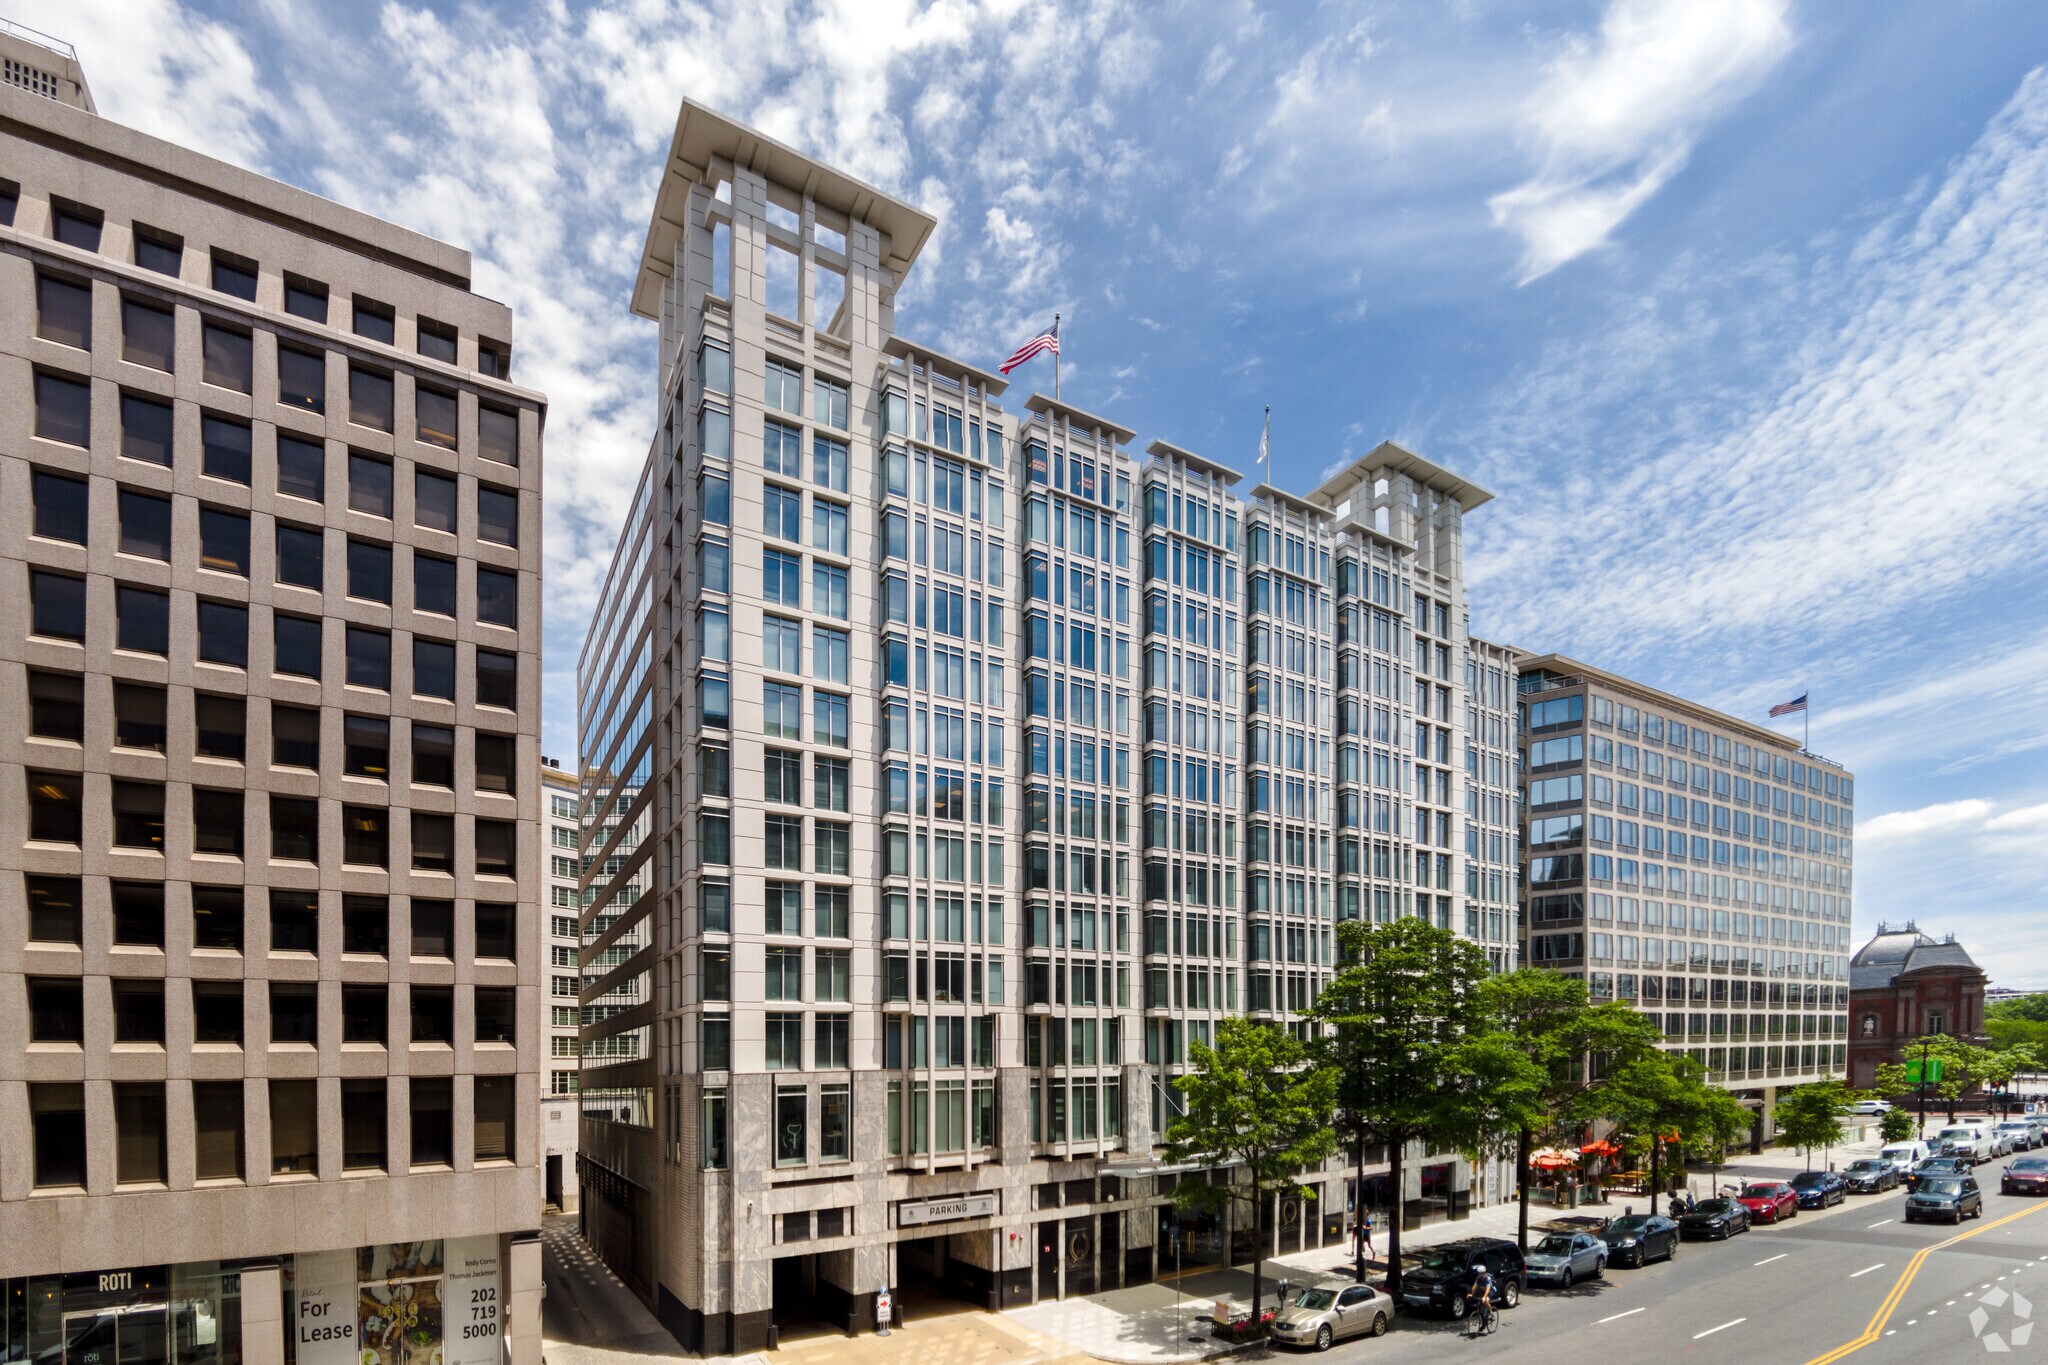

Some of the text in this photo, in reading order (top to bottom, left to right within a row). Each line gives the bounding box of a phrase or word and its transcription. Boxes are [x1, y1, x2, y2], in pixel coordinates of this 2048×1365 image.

[929, 1203, 968, 1217] PARKING
[99, 1272, 132, 1292] ROTI
[472, 1270, 497, 1278] Jackman
[471, 1287, 496, 1303] 202
[300, 1301, 331, 1319] For
[471, 1305, 496, 1321] 719
[301, 1324, 353, 1344] Lease
[463, 1323, 497, 1339] 5000
